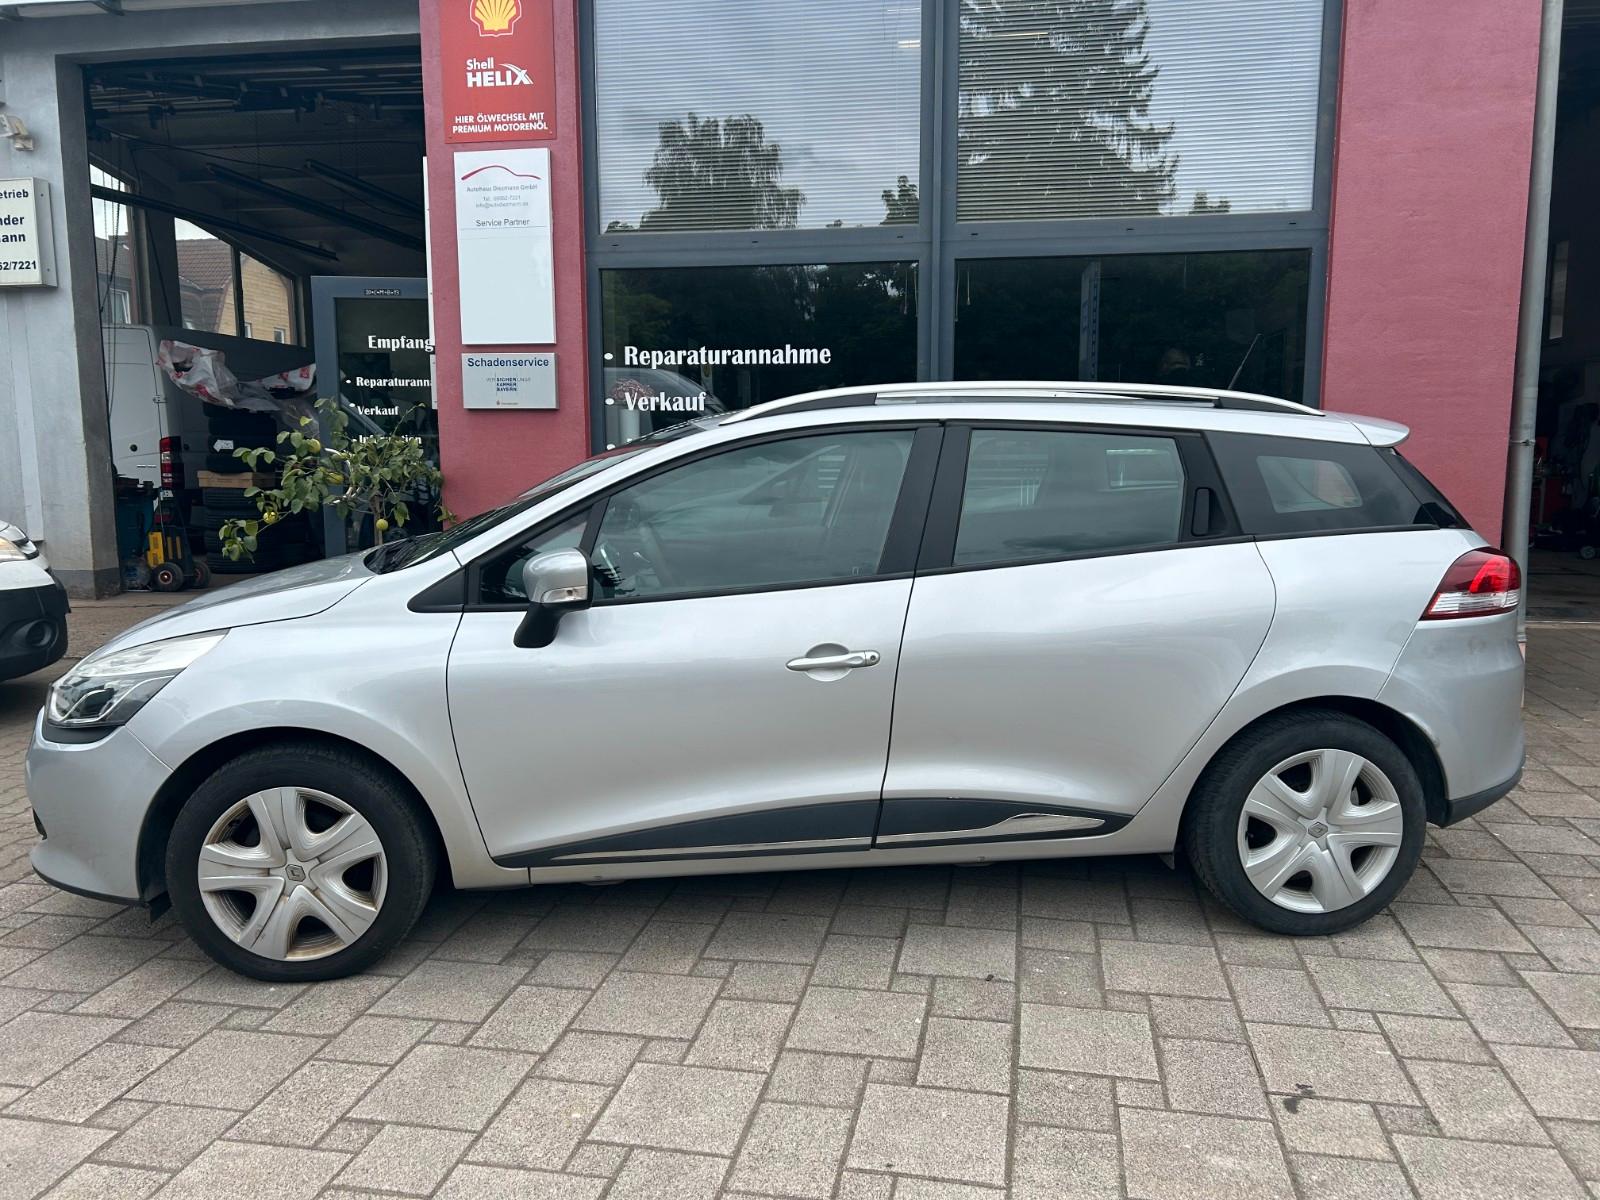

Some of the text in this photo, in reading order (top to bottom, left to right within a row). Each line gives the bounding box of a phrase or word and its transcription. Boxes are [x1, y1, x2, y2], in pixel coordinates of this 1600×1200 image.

[466, 57, 494, 70] Shell
[466, 64, 534, 88] HELIX
[455, 112, 545, 124] HIER ÖLWECHSEL MIT
[452, 119, 548, 133] PREMIUM MOTORENÖL
[475, 218, 530, 227] Service Partner
[0, 233, 26, 243] ann
[368, 335, 434, 352] Empfang
[467, 357, 549, 367] Schadenservice
[624, 344, 832, 369] Reparaturannahme
[356, 376, 432, 388] Reparaturann
[625, 391, 706, 411] Verkauf
[357, 406, 400, 415] Verkauf
